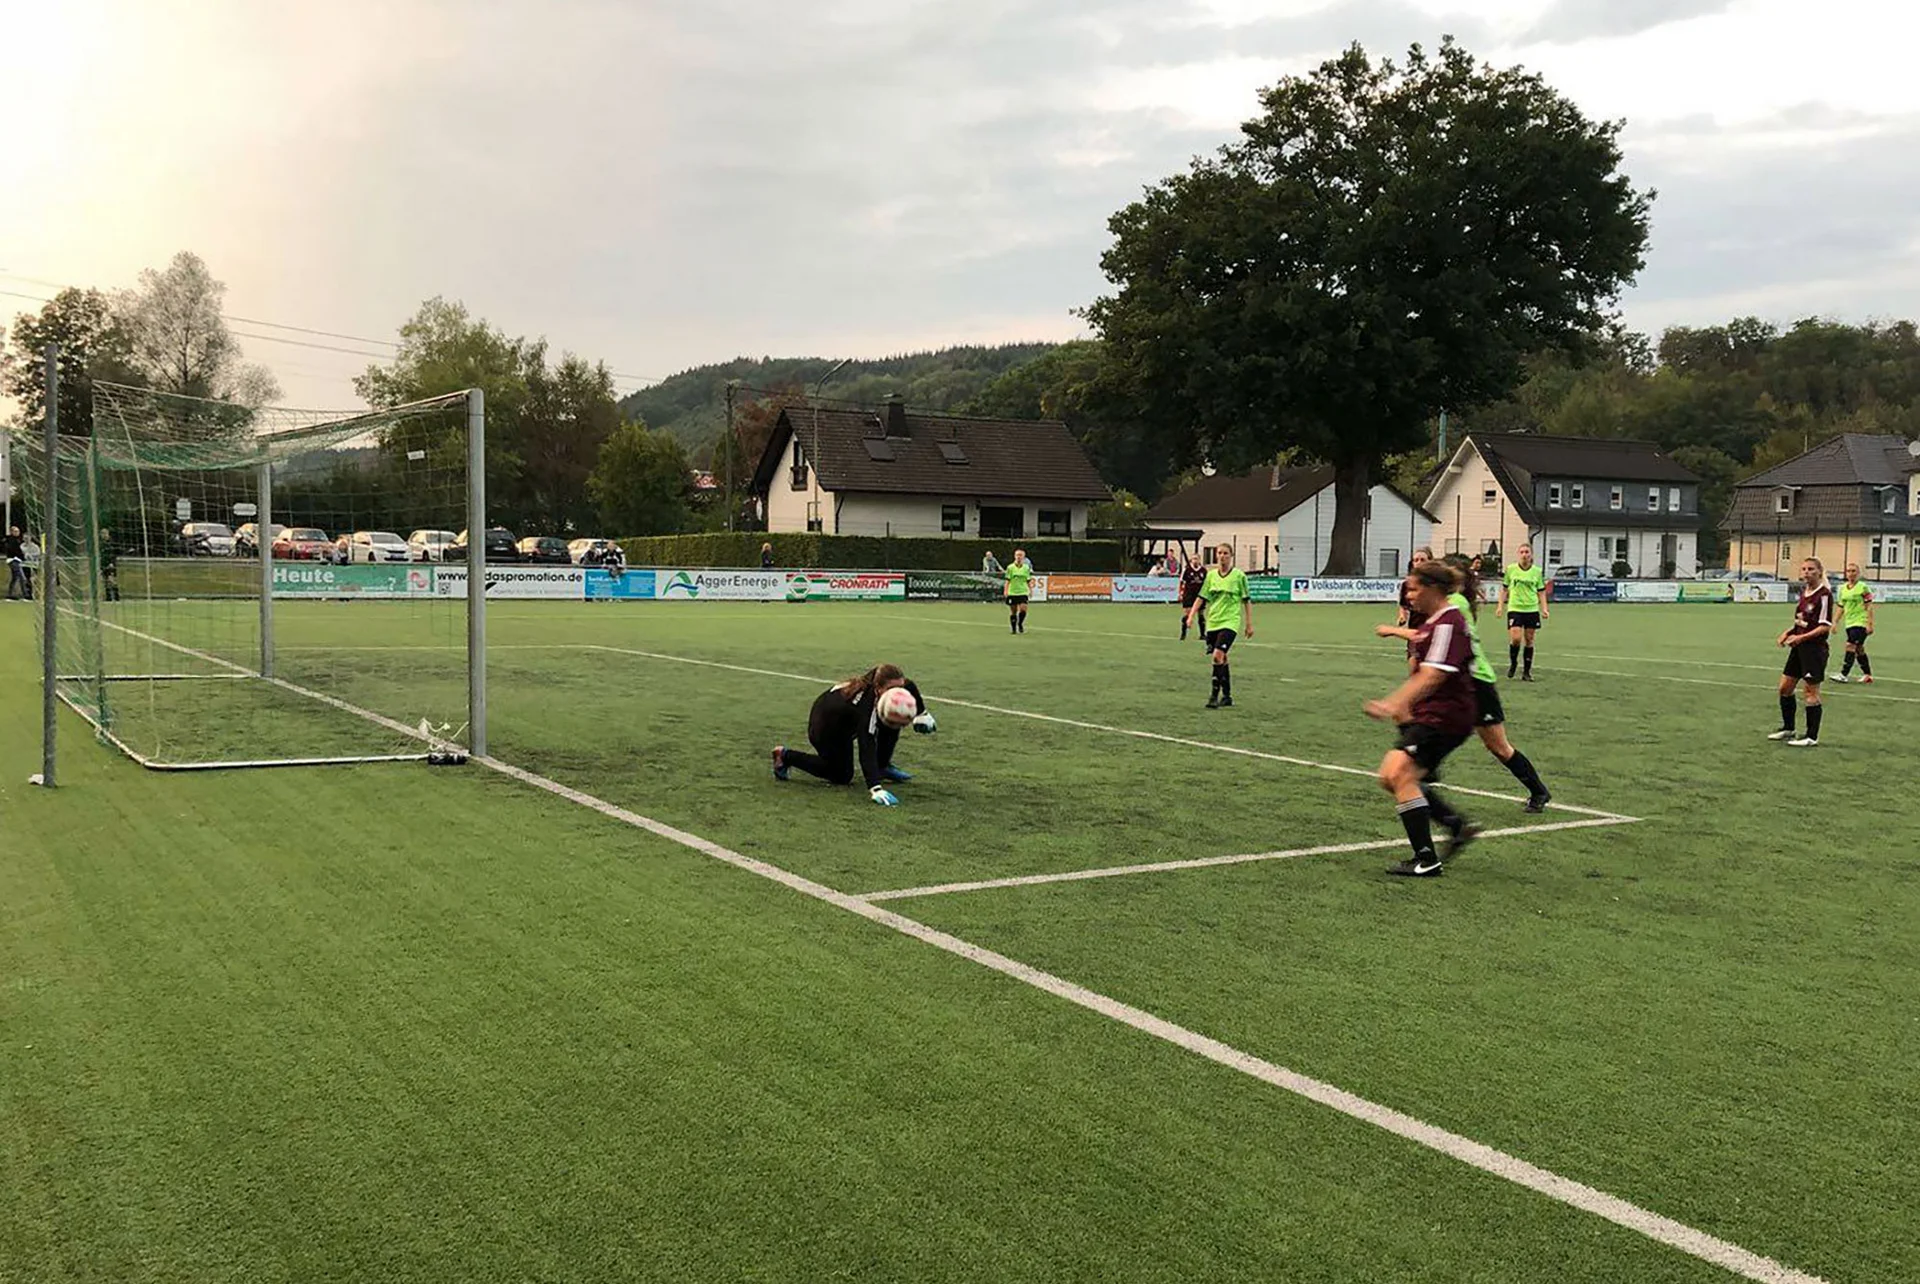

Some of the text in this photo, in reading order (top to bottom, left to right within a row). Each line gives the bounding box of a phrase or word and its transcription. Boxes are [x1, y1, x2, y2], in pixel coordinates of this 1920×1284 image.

[273, 568, 335, 583] Heute
[695, 574, 779, 589] AggerEnergie
[830, 578, 889, 589] CRONRATH
[1311, 580, 1353, 590] Volksbank
[1356, 580, 1395, 593] Oberberg
